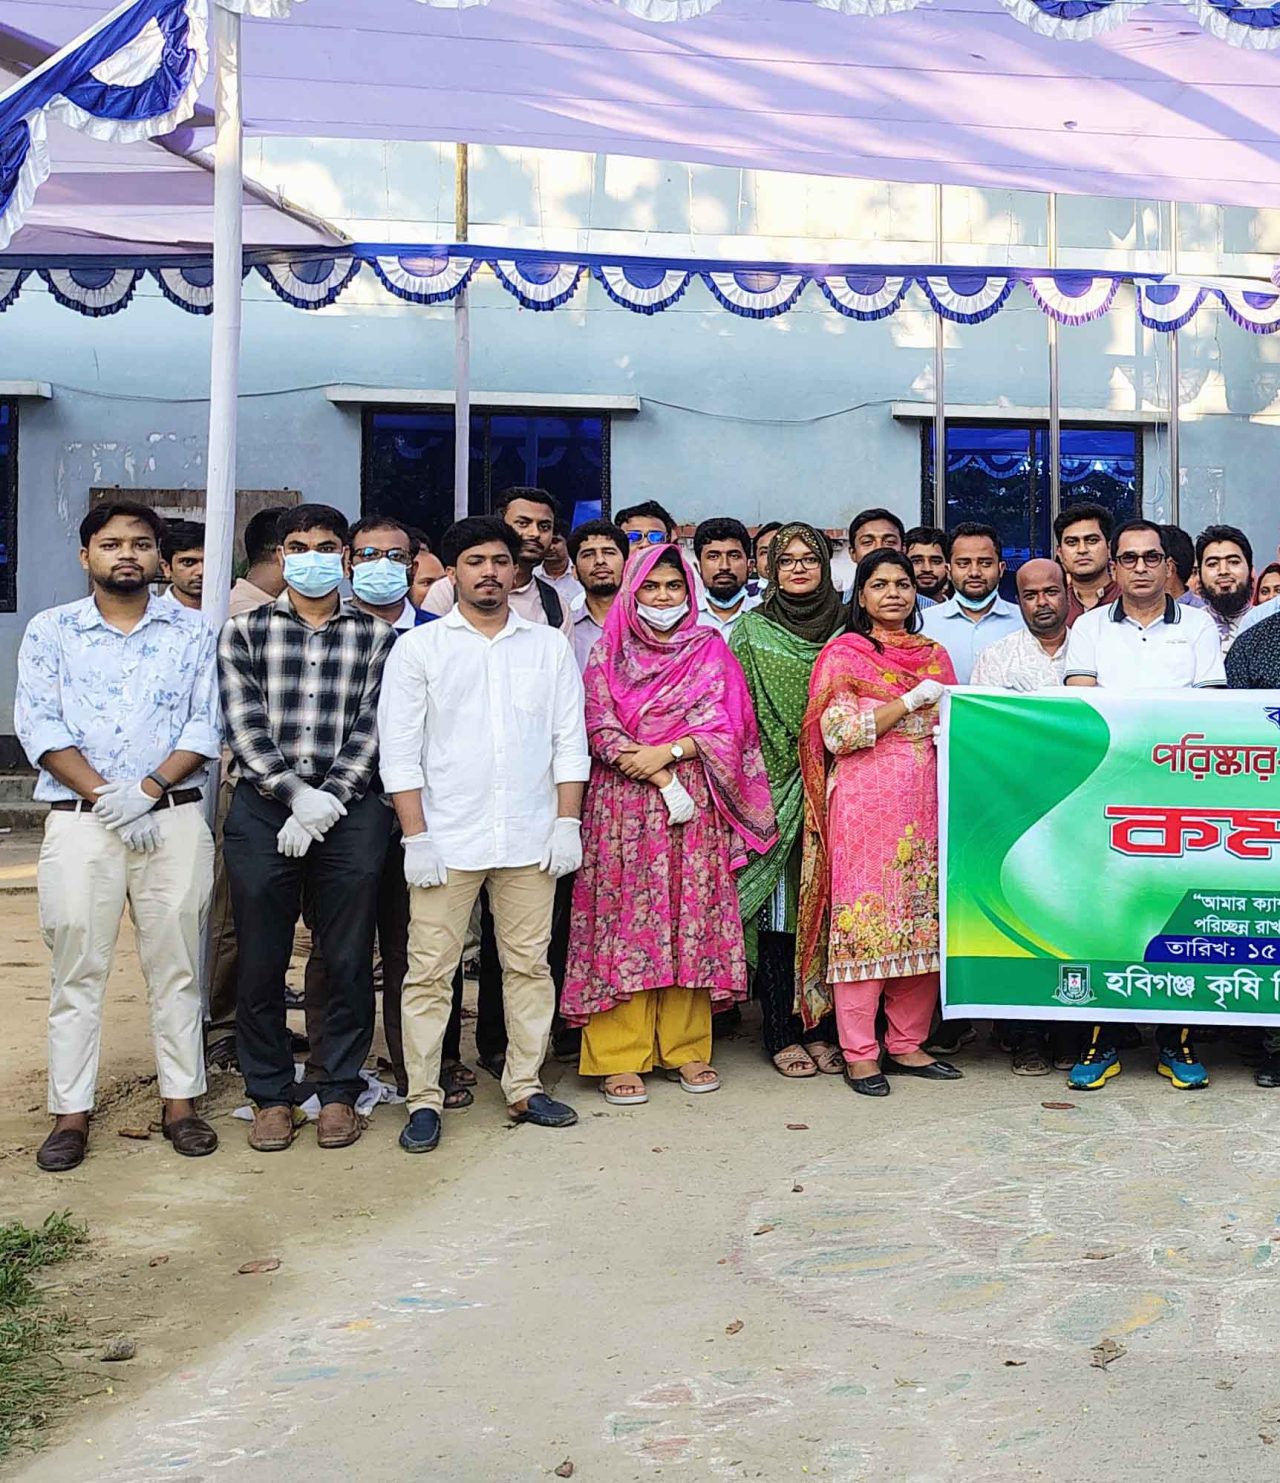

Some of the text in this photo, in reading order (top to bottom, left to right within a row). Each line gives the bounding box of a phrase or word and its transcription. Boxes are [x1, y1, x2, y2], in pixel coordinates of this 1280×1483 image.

[1193, 914, 1250, 936] পরিচ্ছন্ন
[1247, 943, 1277, 960] ১৫
[1103, 965, 1196, 999] হবিগঞ্জ
[1205, 968, 1263, 1010] কৃষি
